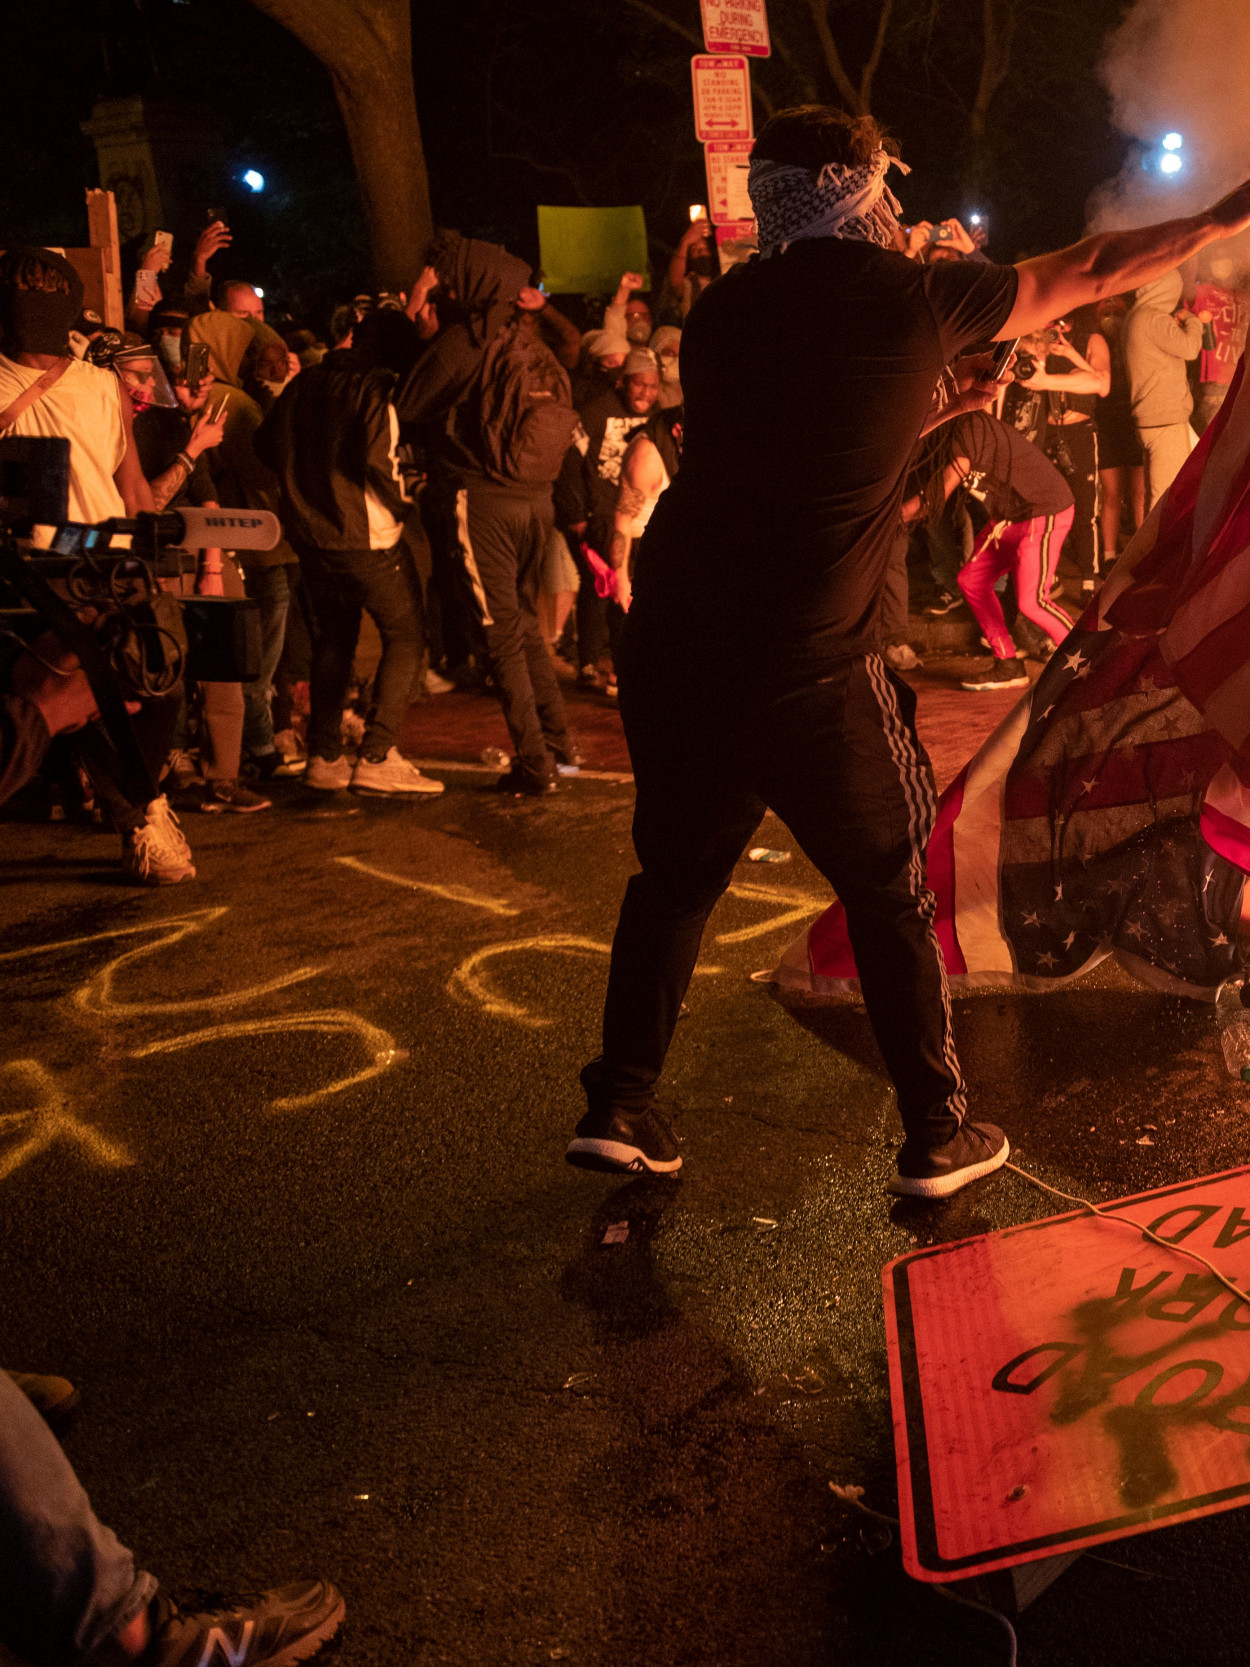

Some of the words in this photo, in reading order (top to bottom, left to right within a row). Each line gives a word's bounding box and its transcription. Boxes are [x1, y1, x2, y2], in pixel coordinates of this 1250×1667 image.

[720, 11, 753, 27] DURING
[709, 26, 764, 43] EMERGENCY
[715, 71, 727, 79] NO
